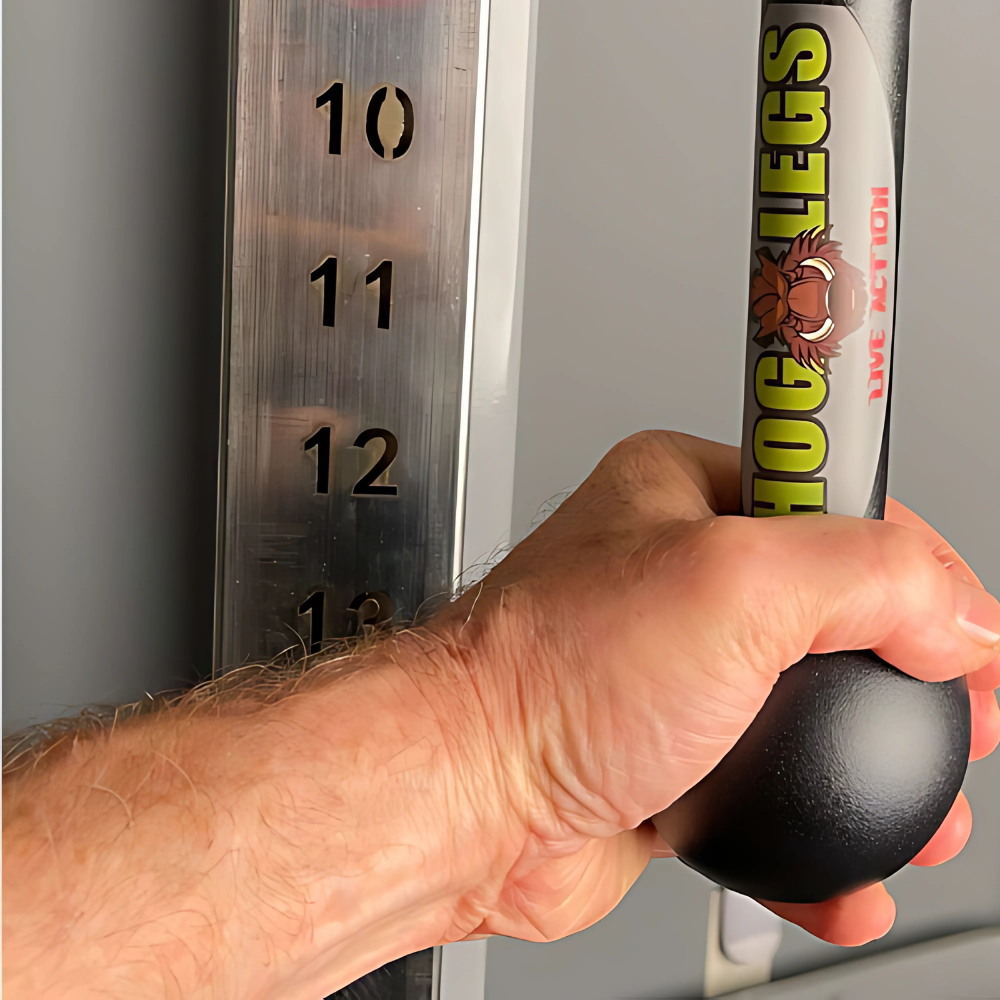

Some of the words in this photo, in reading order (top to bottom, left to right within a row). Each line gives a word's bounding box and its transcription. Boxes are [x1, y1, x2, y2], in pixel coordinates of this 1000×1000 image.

[315, 82, 415, 160] 10
[758, 22, 831, 241] LEGS
[868, 187, 888, 317] ACTION
[310, 256, 393, 330] 11
[867, 329, 886, 407] LIVE
[304, 426, 399, 497] 12
[752, 350, 830, 517] HOG
